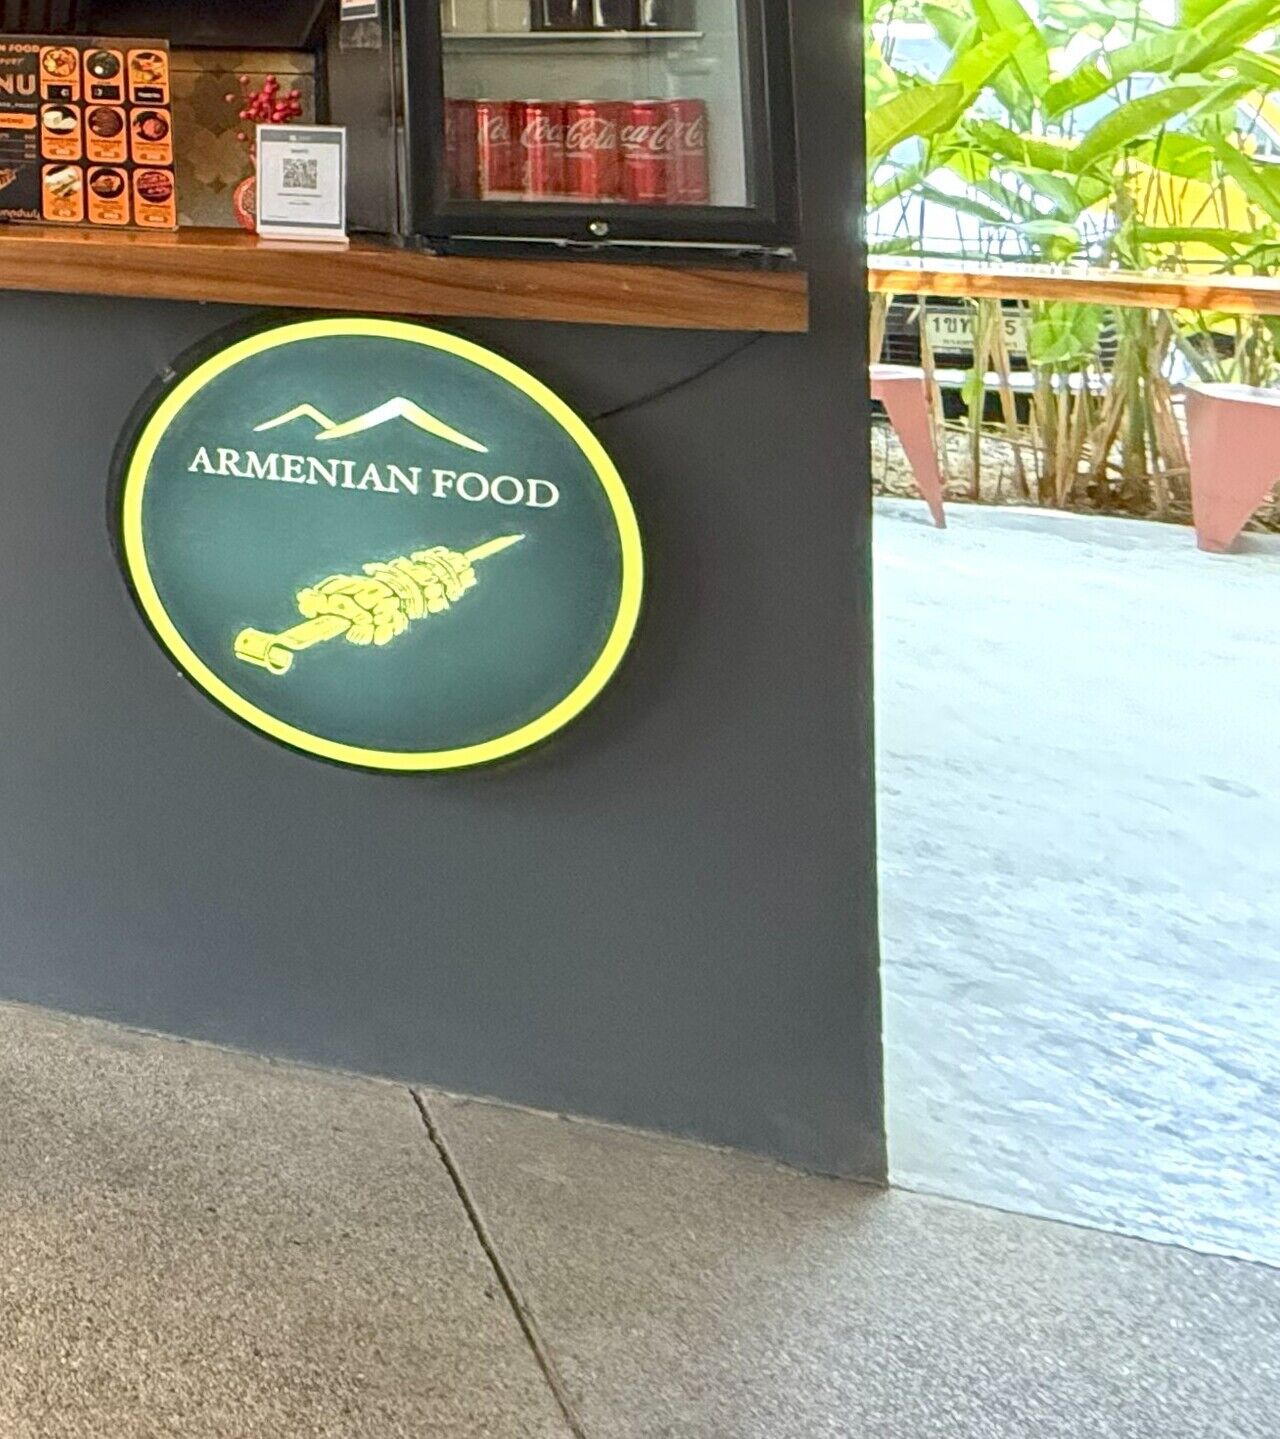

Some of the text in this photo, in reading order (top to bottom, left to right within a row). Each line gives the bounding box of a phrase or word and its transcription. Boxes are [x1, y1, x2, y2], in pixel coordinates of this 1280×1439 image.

[8, 44, 40, 53] FOOD
[188, 446, 560, 508] ARMENIAN FOOD
